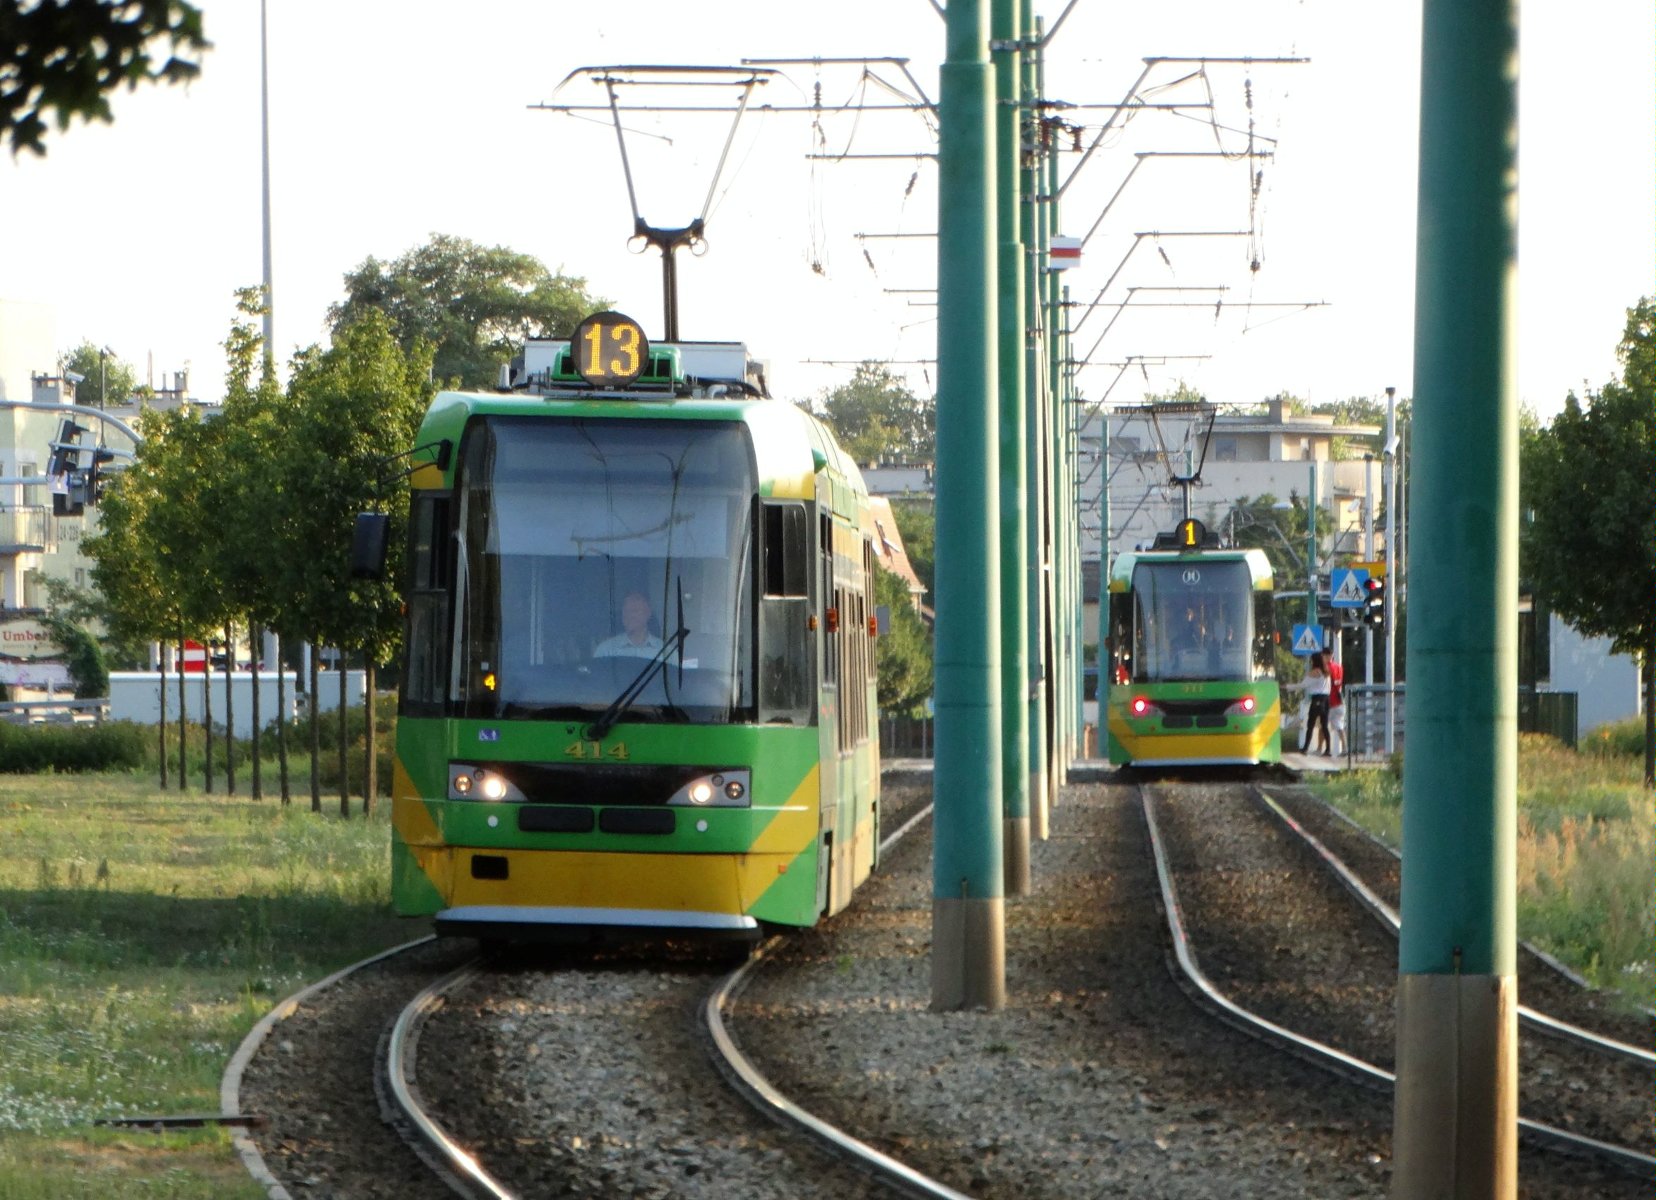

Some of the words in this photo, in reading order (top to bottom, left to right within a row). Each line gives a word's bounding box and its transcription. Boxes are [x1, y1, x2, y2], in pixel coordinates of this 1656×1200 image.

[585, 323, 640, 376] 13
[1185, 520, 1196, 545] 1
[484, 674, 496, 691] 4
[564, 741, 629, 760] 414
